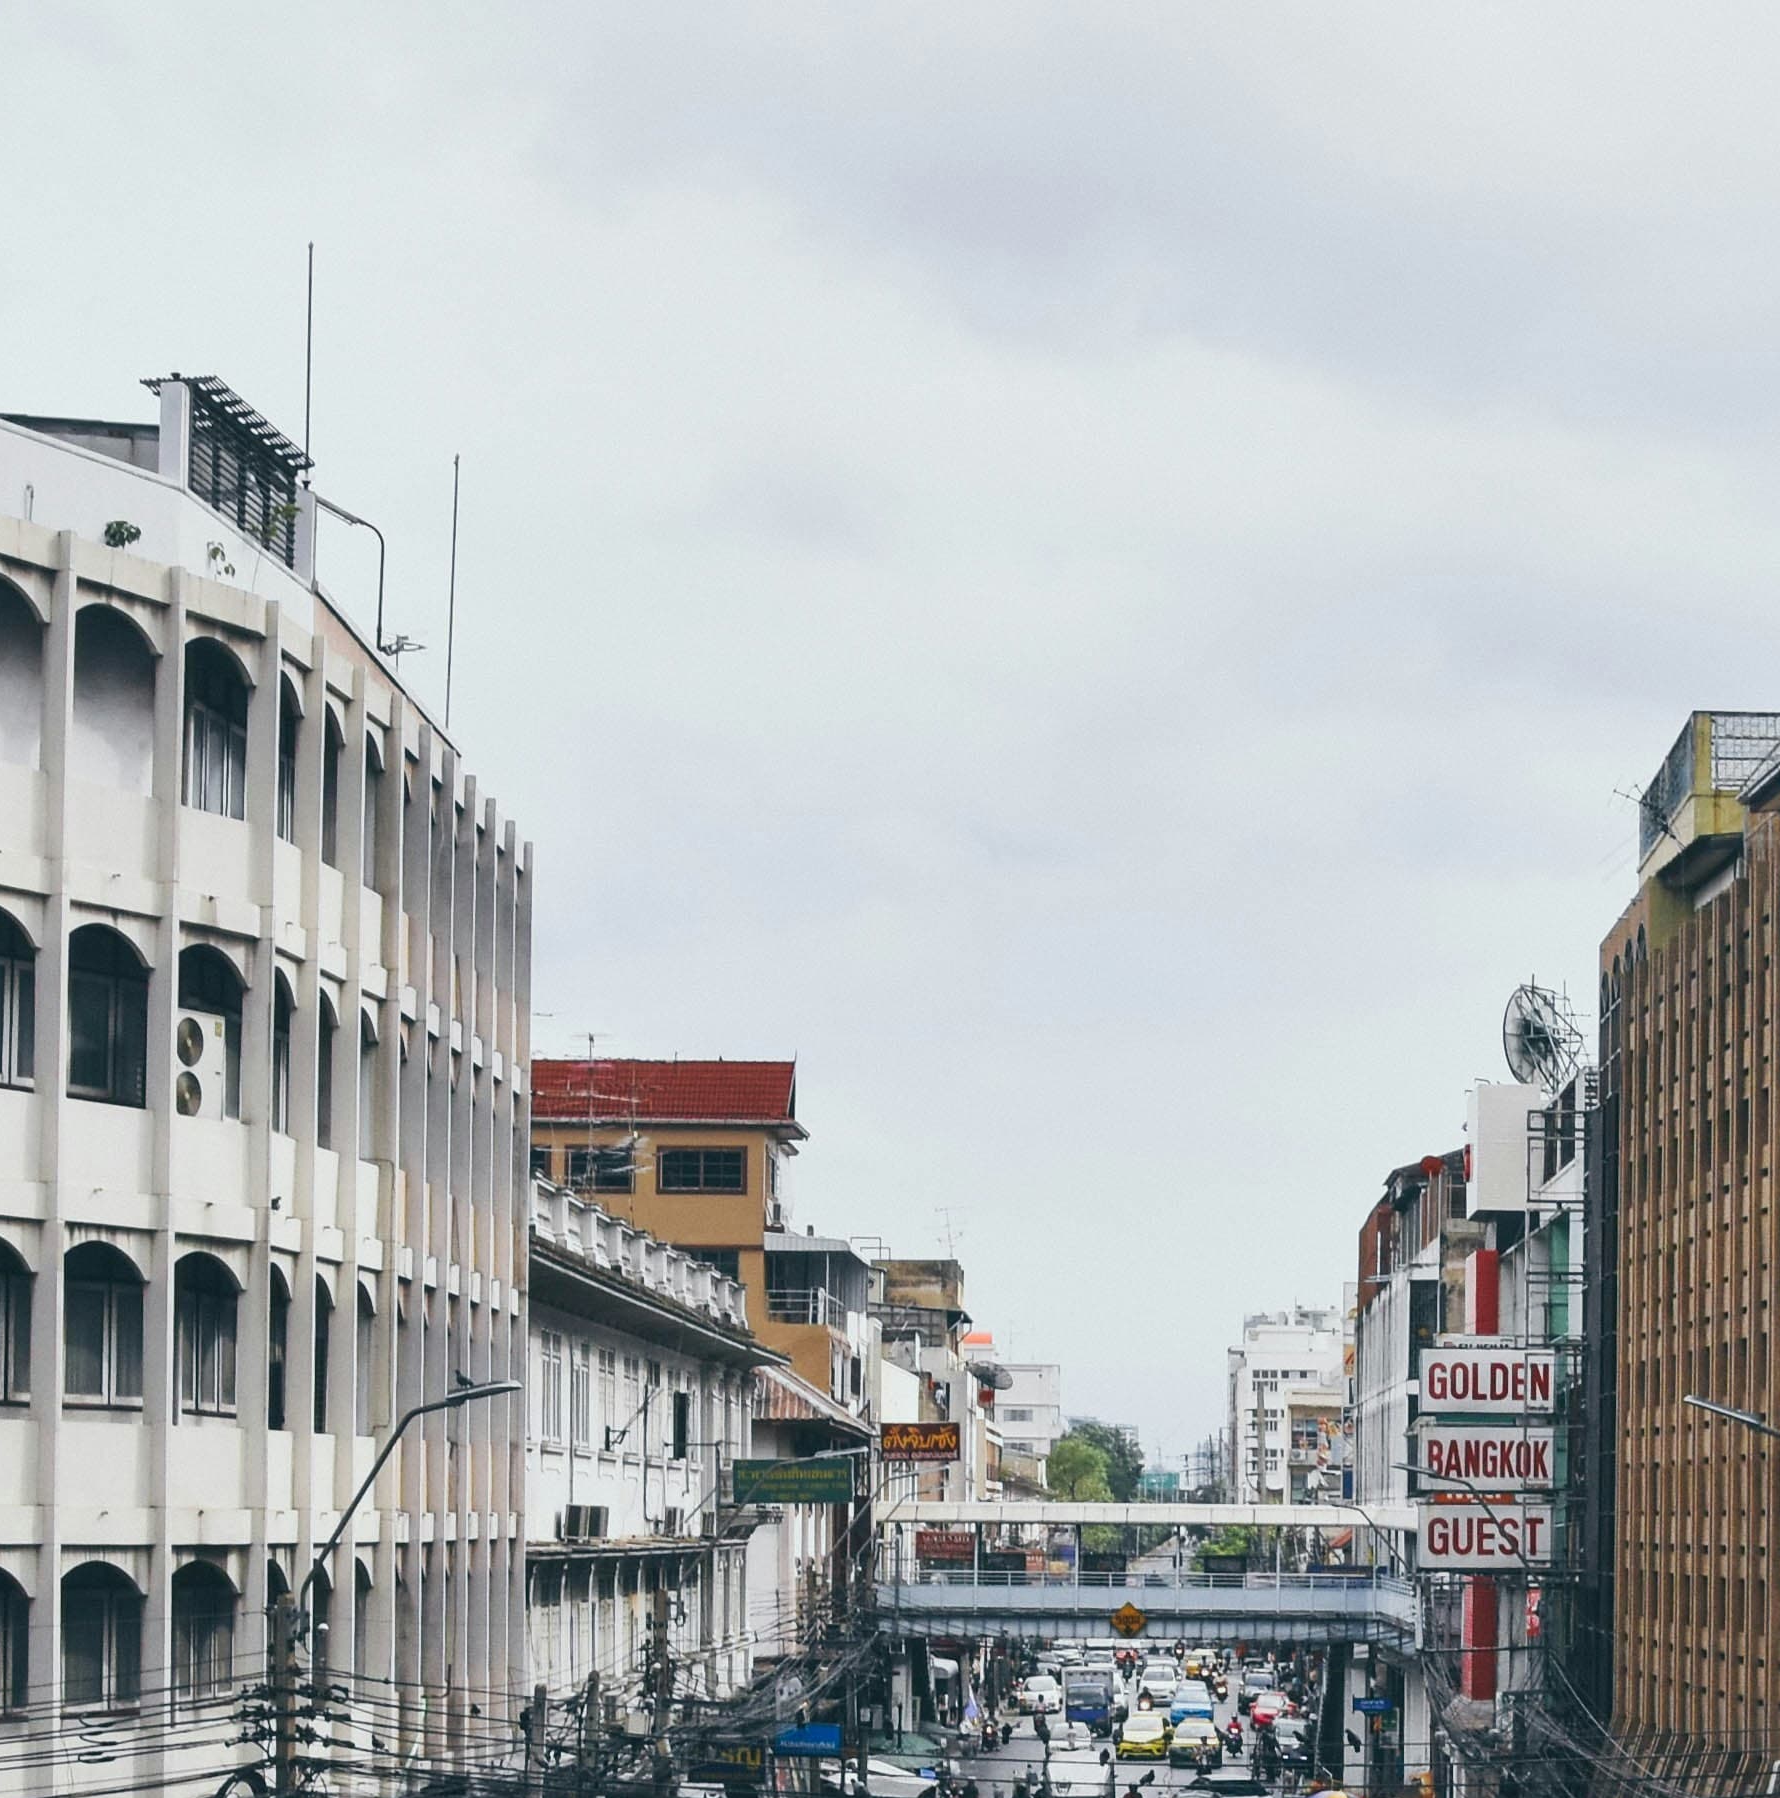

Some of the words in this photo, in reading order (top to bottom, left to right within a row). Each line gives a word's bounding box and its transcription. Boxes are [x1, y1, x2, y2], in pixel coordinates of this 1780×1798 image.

[1428, 1361, 1550, 1401] GOLDEN
[1427, 1439, 1549, 1479] BANGKOK
[1427, 1517, 1545, 1557] GUEST
